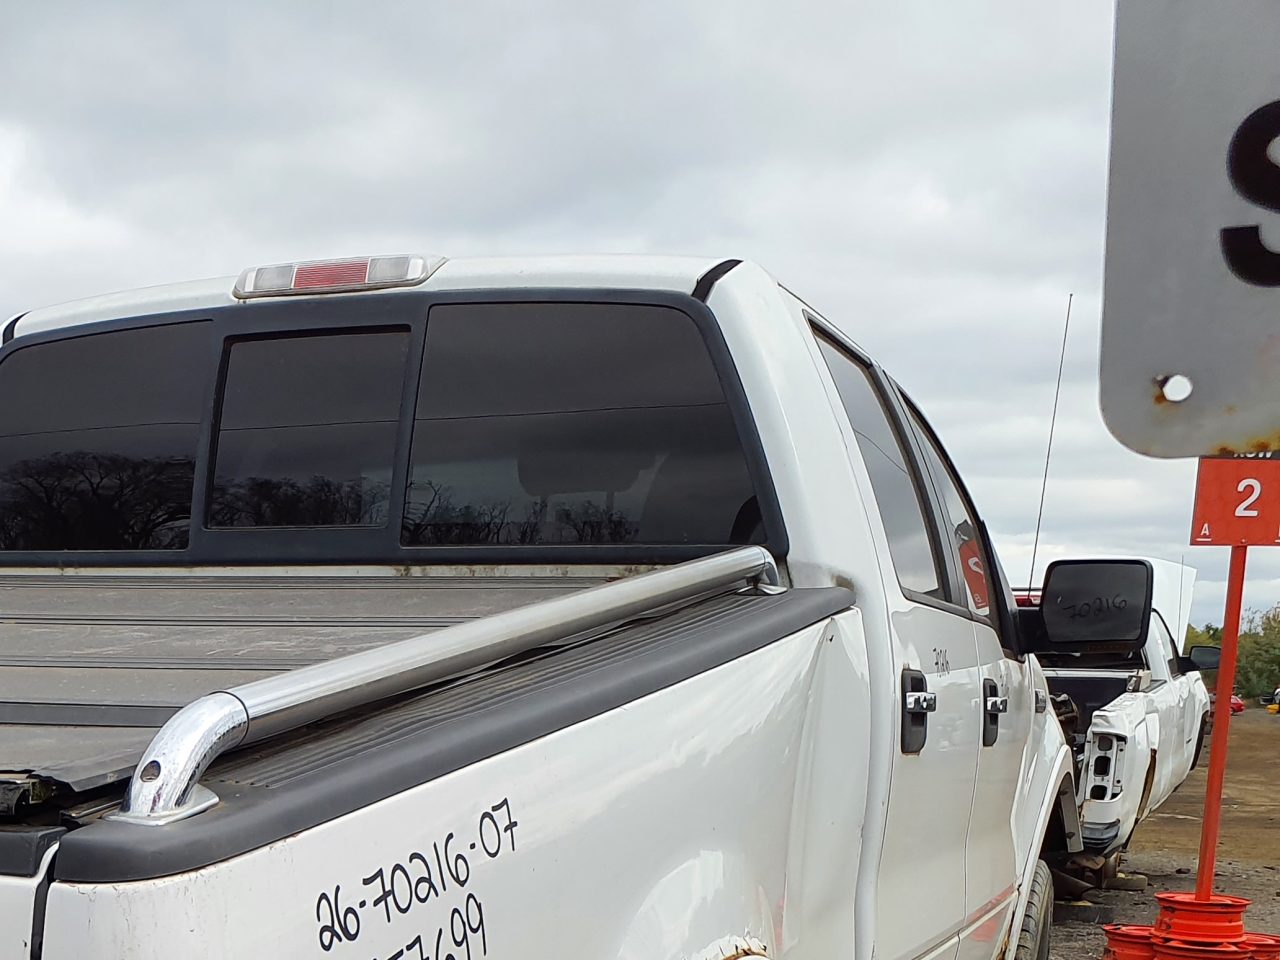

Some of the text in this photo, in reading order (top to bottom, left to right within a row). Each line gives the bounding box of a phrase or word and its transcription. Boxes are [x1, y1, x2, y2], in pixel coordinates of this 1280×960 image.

[1235, 478, 1262, 517] 2
[1200, 523, 1210, 536] A
[315, 797, 519, 952] 26-70216-07
